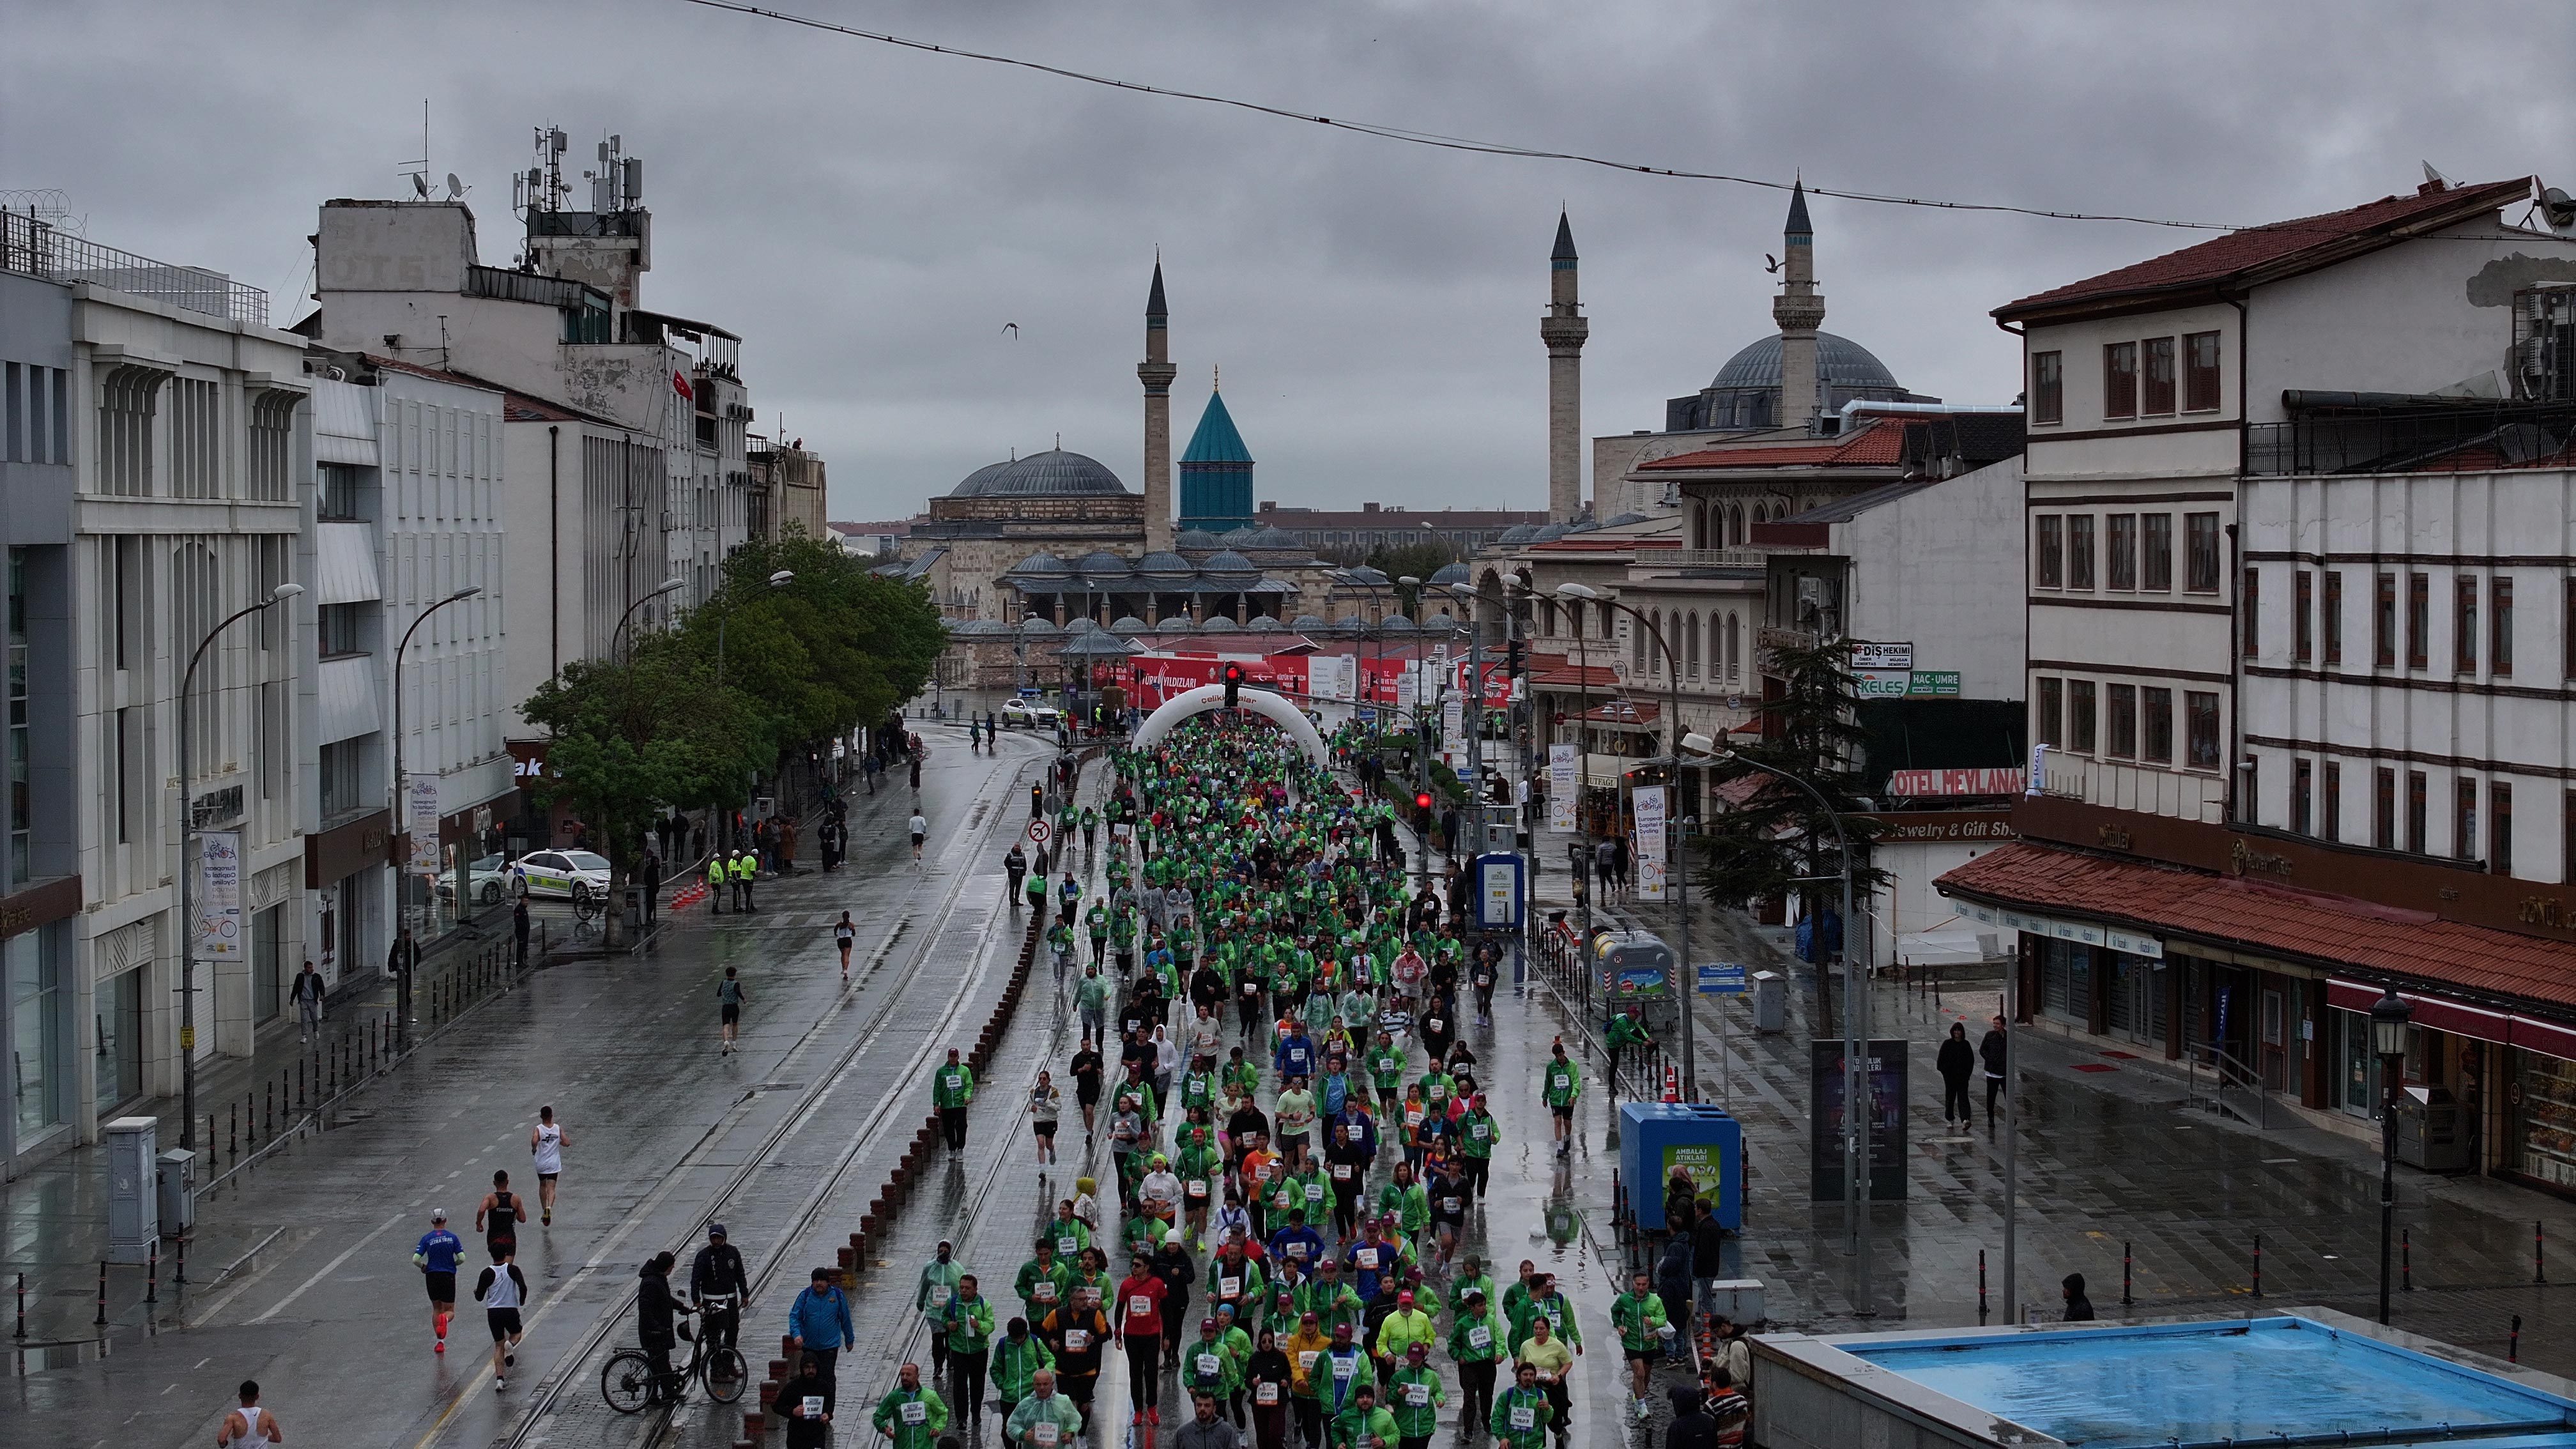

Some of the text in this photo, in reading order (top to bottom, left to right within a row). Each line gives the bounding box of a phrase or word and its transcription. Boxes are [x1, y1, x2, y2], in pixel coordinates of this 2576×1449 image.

[1163, 677, 1196, 688] YILDIZLARI
[1913, 675, 1930, 684] HAC
[1935, 675, 1958, 685] UMRE
[1861, 681, 1903, 697] KELEŞ
[1894, 768, 2021, 796] OTEL MEVLANA
[1949, 823, 1964, 837] &
[1963, 821, 1988, 836] Gift
